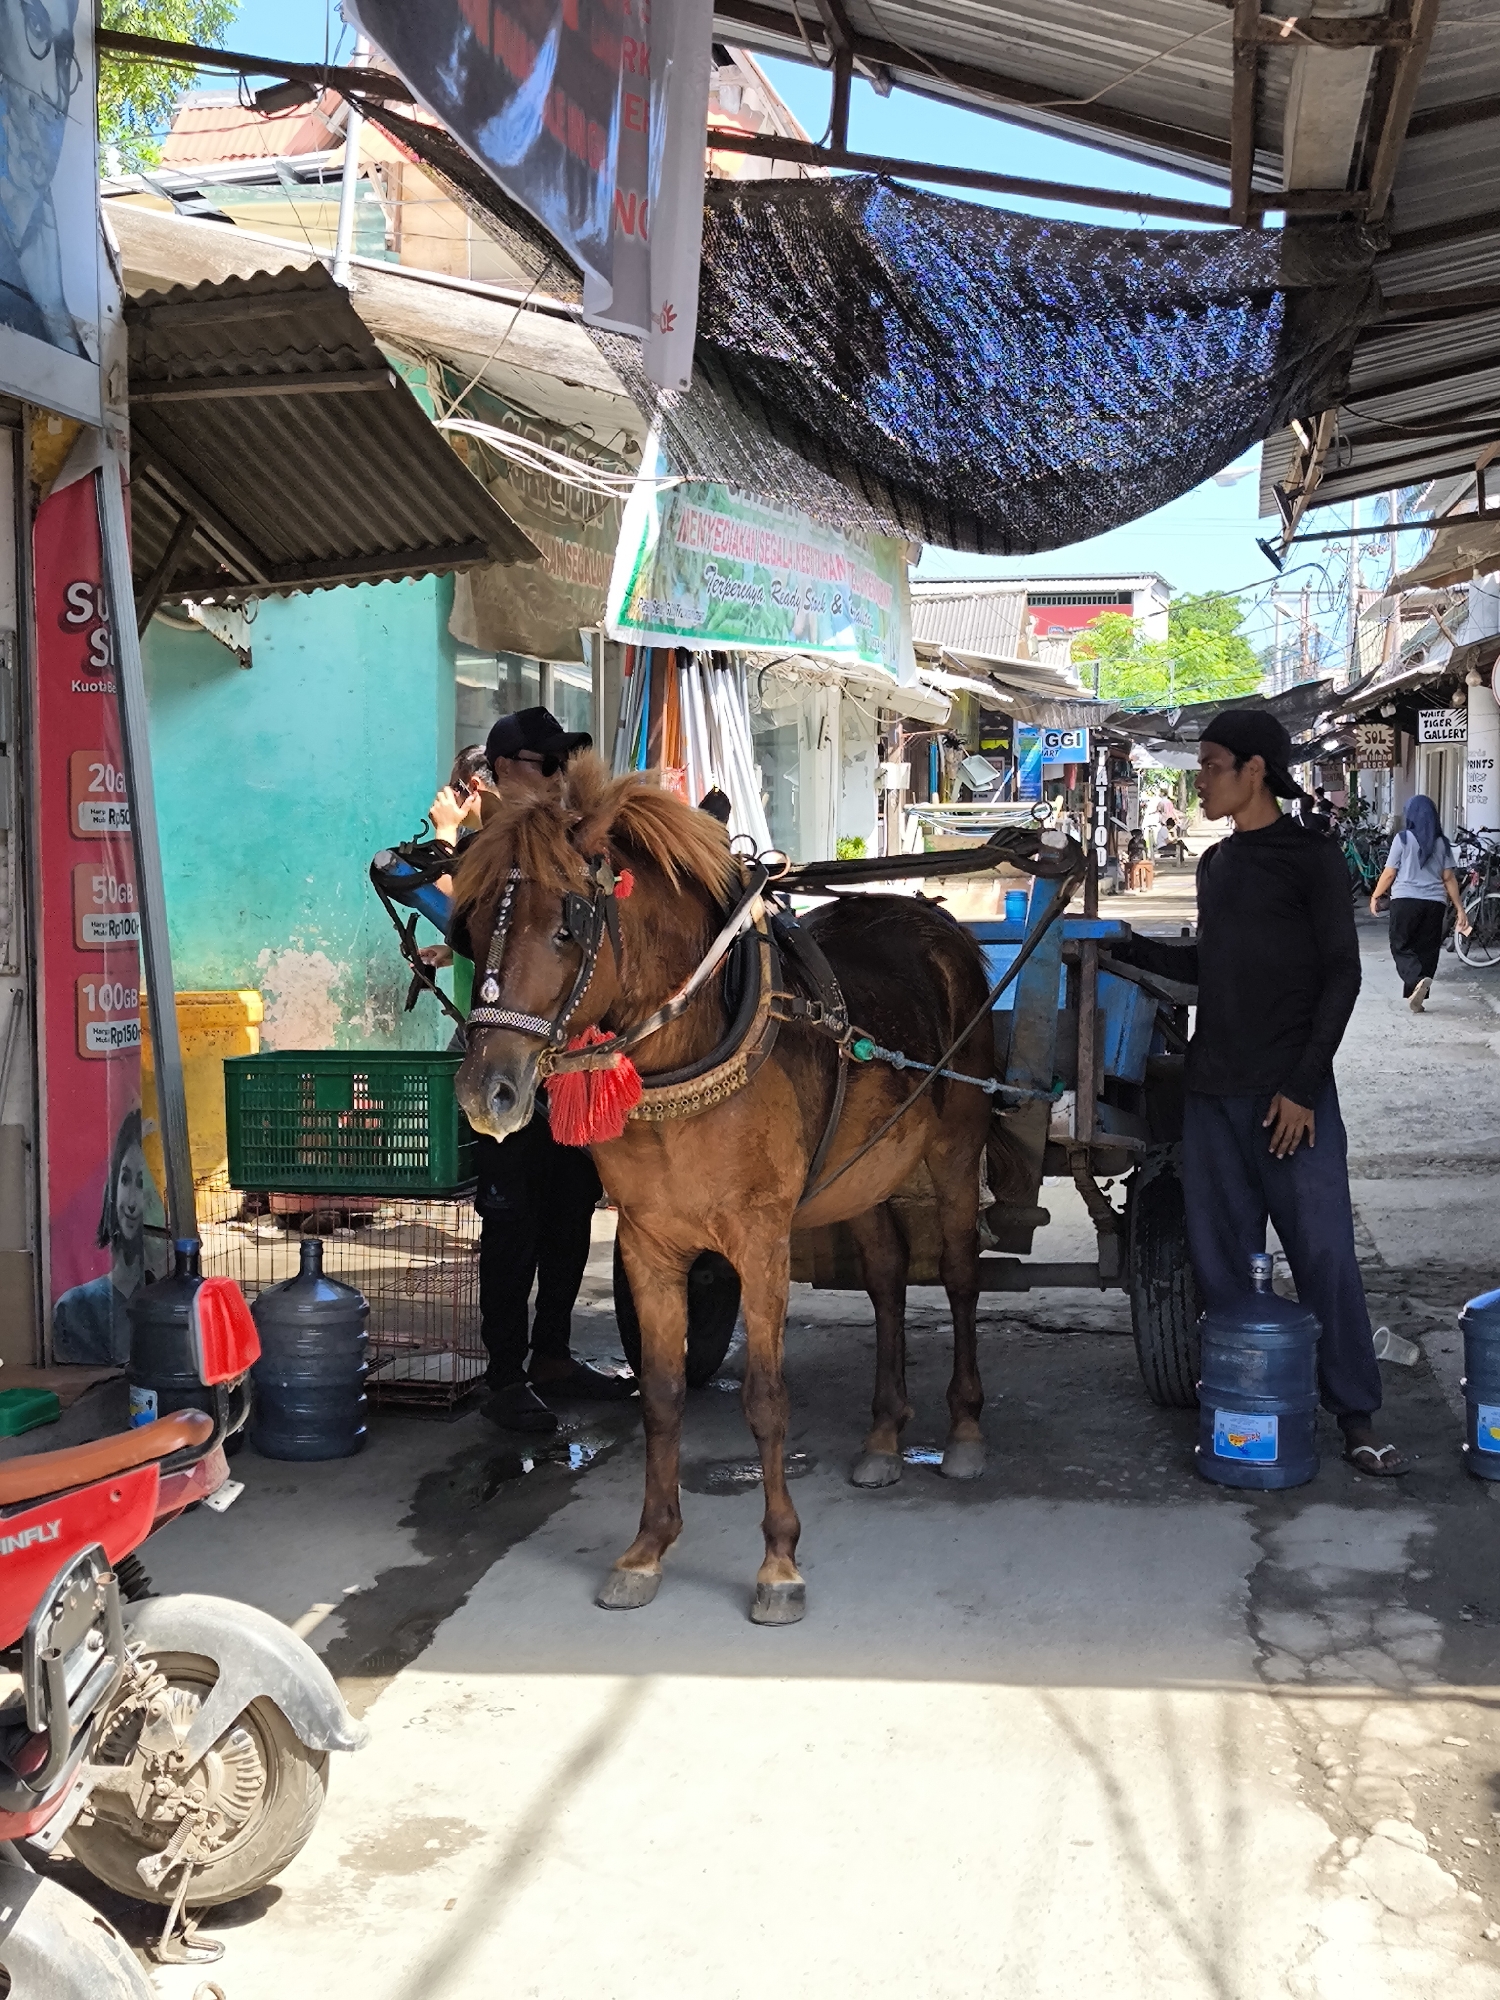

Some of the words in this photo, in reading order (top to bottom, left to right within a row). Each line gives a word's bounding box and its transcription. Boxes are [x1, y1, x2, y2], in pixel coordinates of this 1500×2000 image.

[831, 593, 842, 614] &
[1424, 718, 1452, 728] TIGER
[1044, 732, 1081, 748] GGI
[1365, 730, 1387, 745] SOL
[1424, 729, 1466, 740] GALLERY
[1095, 746, 1108, 867] TATTOO
[92, 875, 134, 905] 50GB
[82, 982, 138, 1012] 100GB
